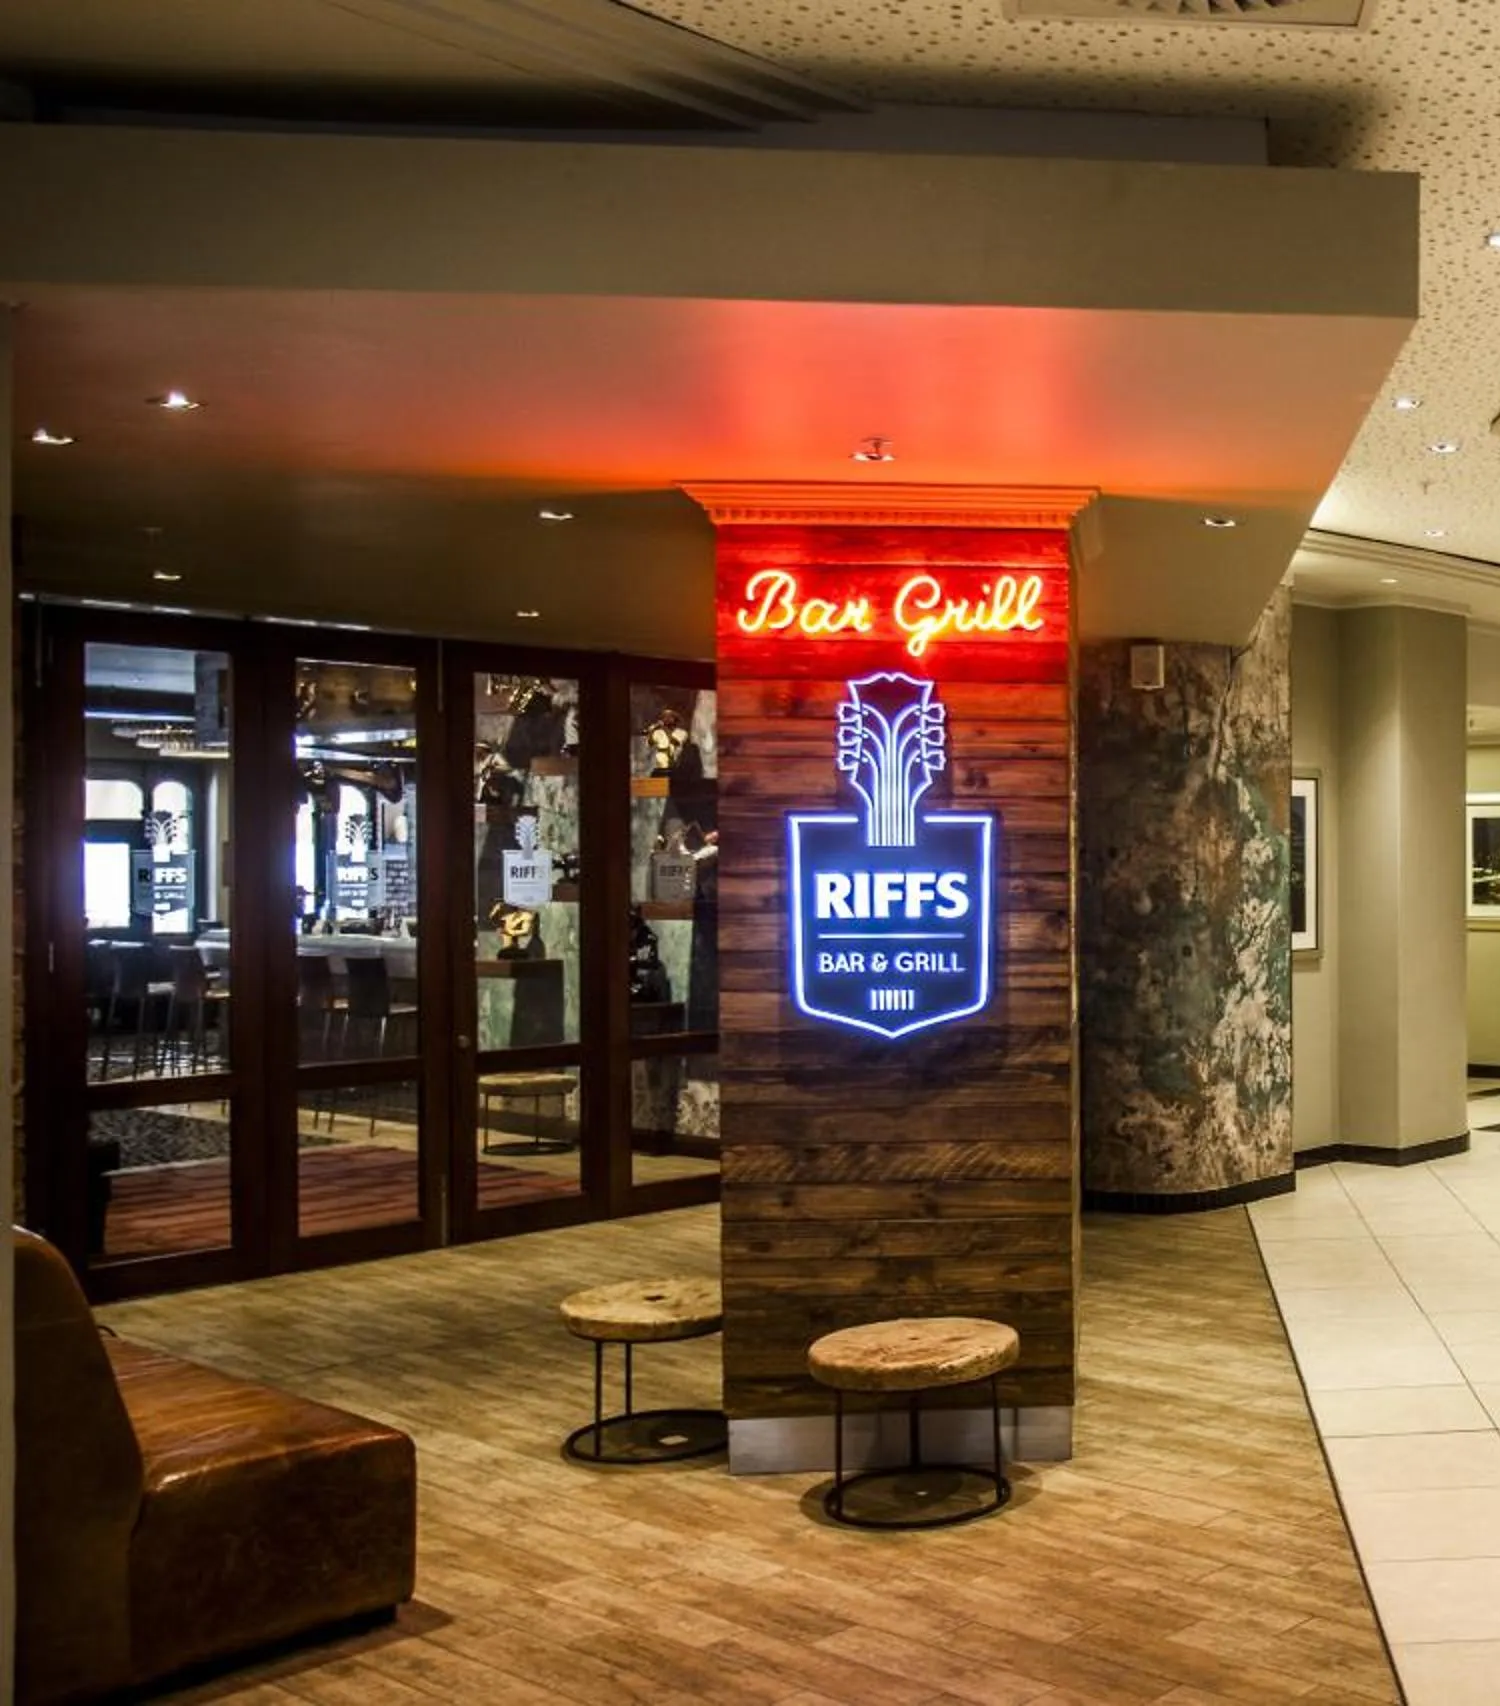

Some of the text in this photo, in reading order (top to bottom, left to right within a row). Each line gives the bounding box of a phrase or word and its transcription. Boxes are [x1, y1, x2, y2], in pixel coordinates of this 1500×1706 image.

[738, 569, 1044, 657] Bar Grill
[815, 872, 970, 919] RIFFS
[819, 952, 966, 974] BAR & GRILL
